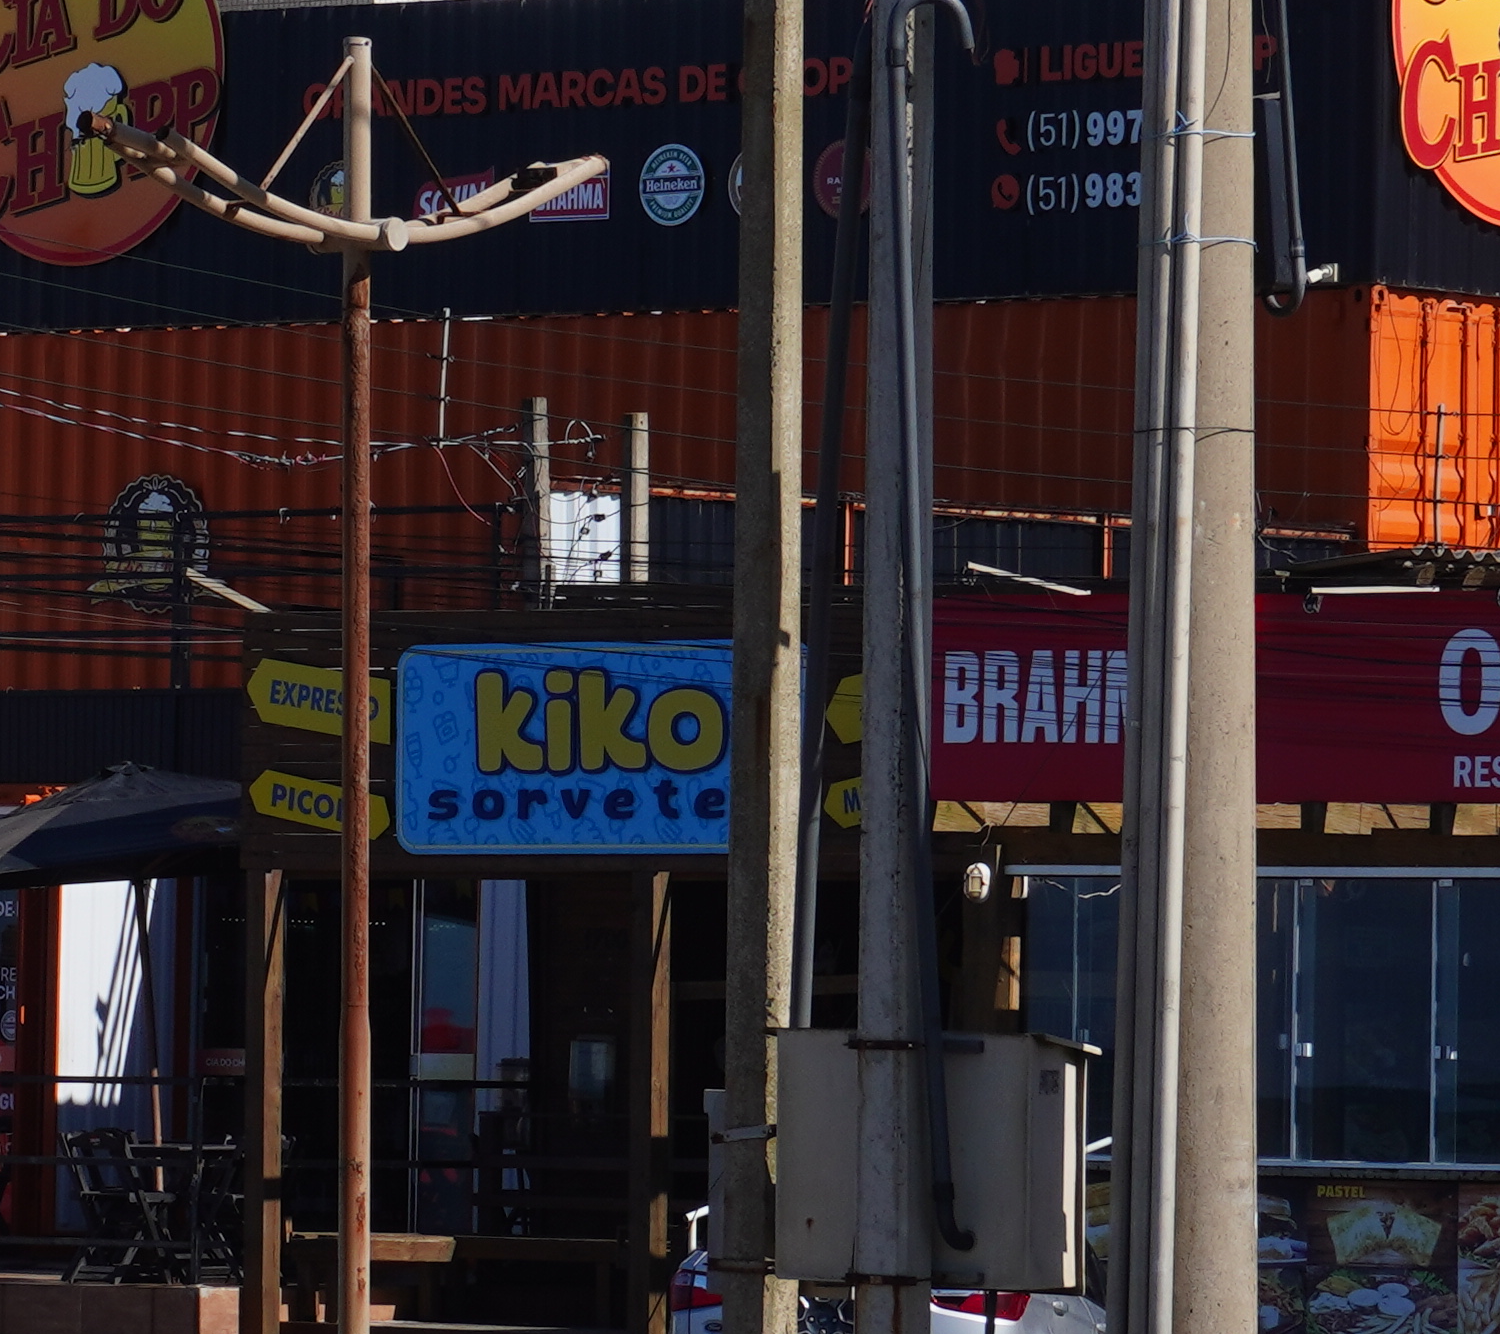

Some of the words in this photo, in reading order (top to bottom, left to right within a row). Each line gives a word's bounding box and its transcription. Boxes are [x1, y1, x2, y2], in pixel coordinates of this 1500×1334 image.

[1040, 40, 1143, 83] LIGUE
[498, 64, 667, 110] MARCAS
[677, 63, 728, 104] DE
[1026, 109, 1080, 154] (51)
[645, 177, 699, 193] Heineken
[1026, 172, 1080, 216] (51)
[475, 666, 729, 775] kiko
[1316, 1185, 1366, 1199] PASTEL
